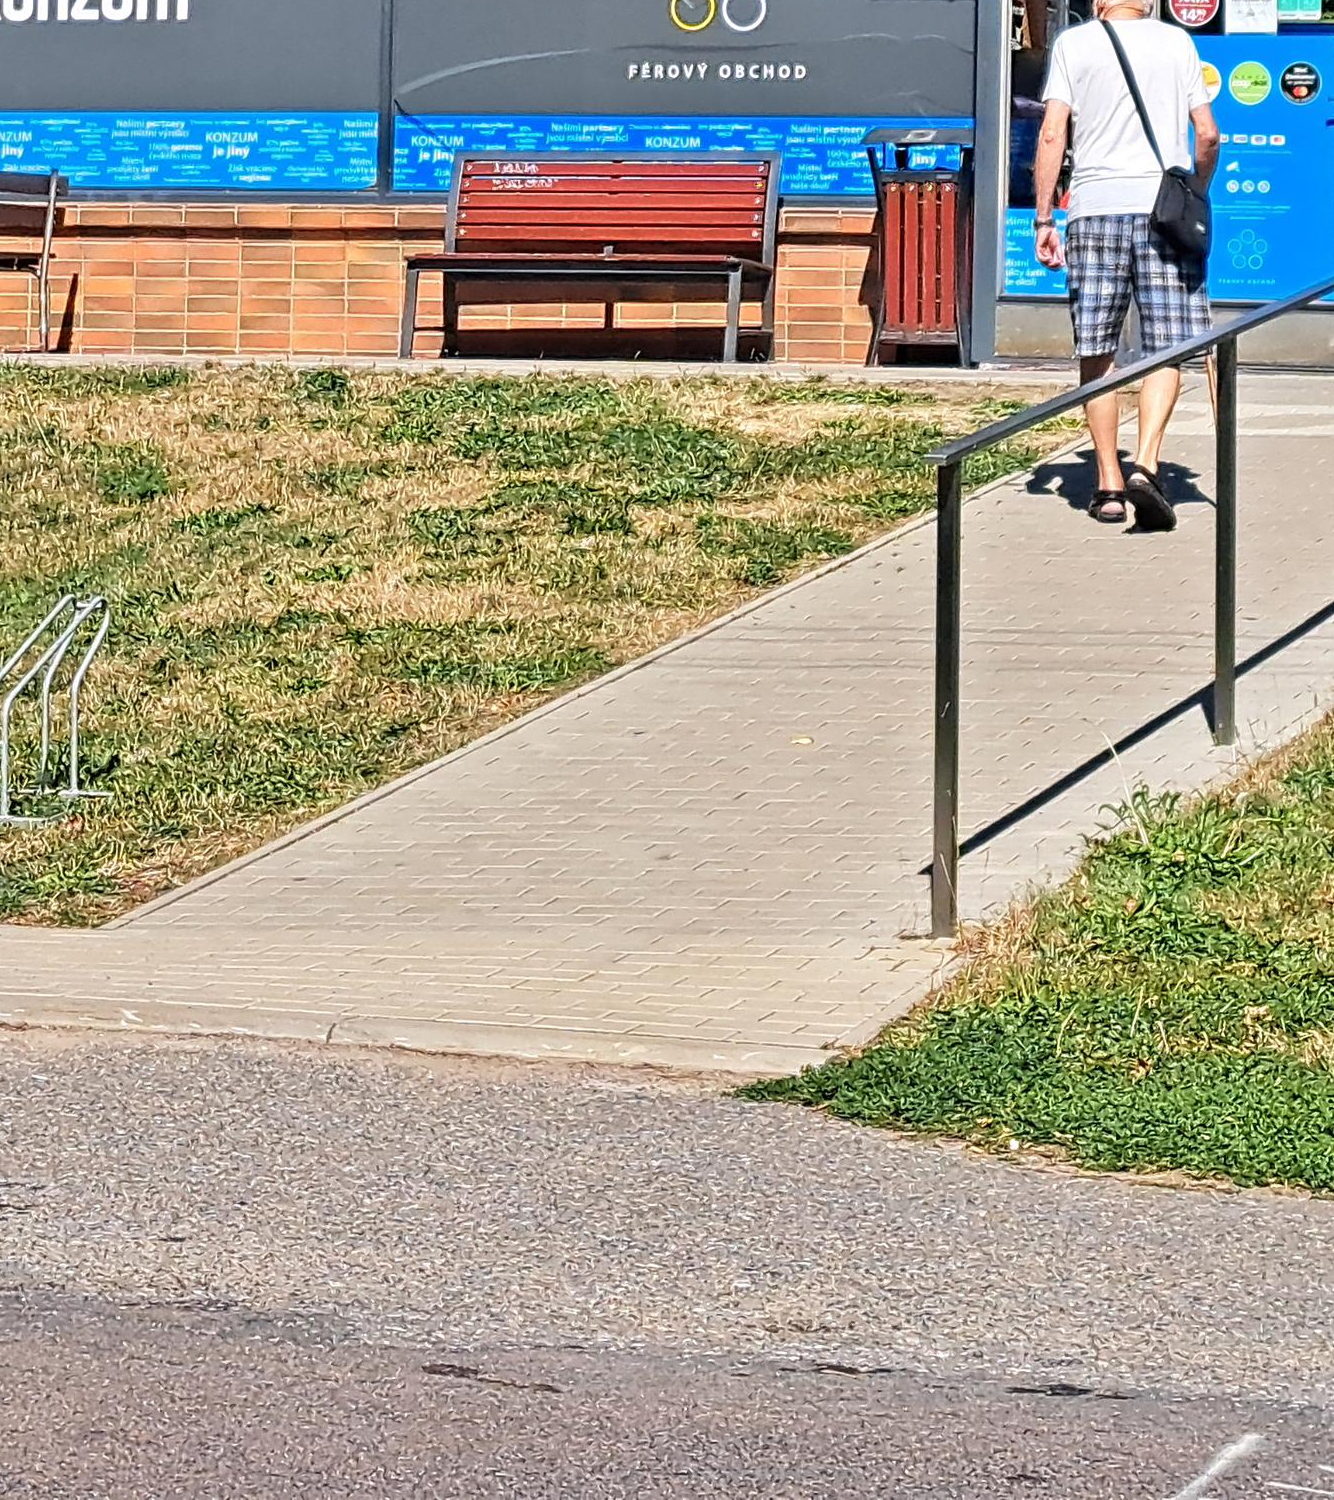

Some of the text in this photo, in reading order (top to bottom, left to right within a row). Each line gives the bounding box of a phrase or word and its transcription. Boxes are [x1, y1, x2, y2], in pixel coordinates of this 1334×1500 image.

[627, 61, 808, 80] FÉROVÝ OBCHOD
[823, 126, 867, 135] partnery
[205, 131, 259, 143] KONZUM
[411, 136, 464, 147] KONZUM
[645, 137, 701, 149] KONZUM
[212, 144, 225, 160] je
[226, 144, 251, 160] jiný
[418, 149, 430, 162] je
